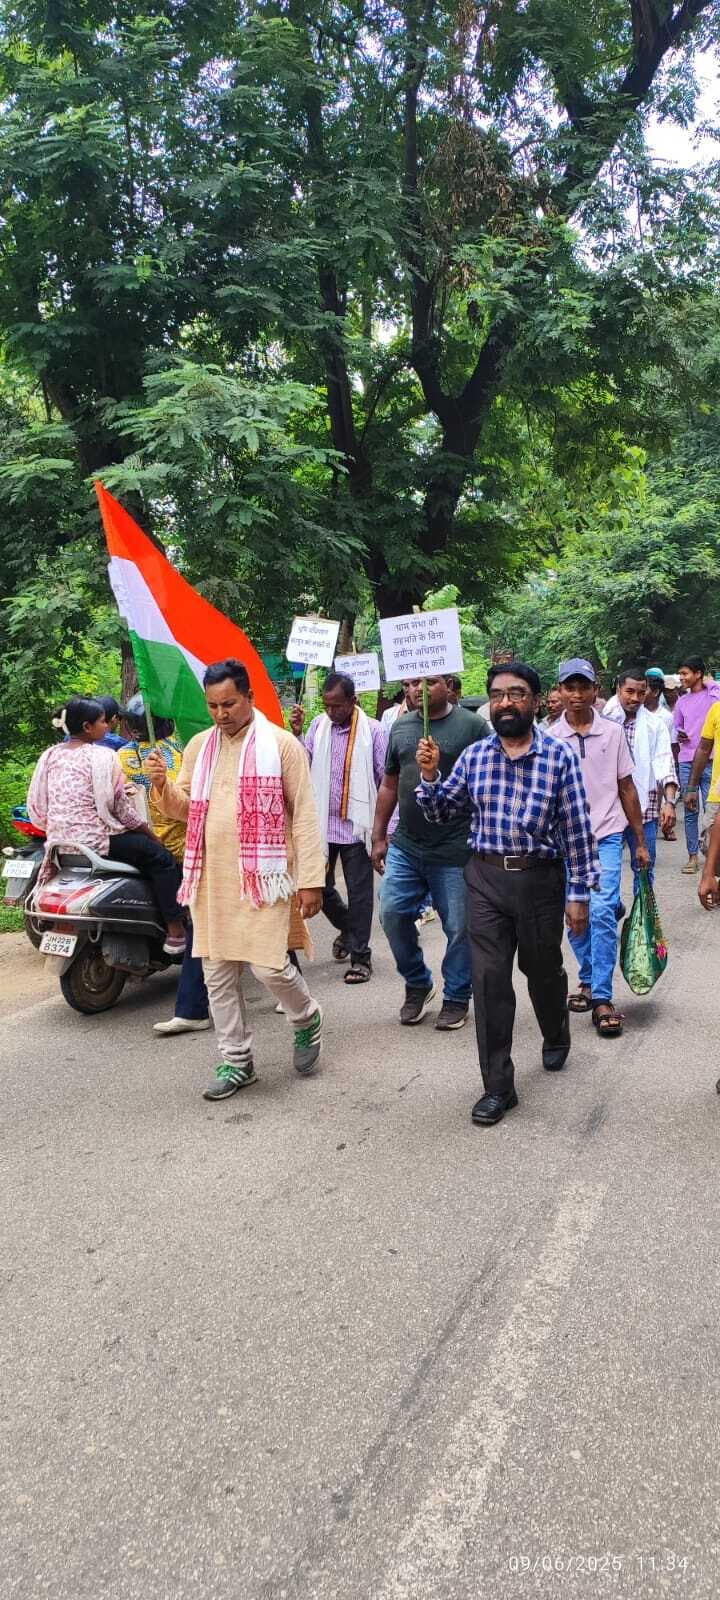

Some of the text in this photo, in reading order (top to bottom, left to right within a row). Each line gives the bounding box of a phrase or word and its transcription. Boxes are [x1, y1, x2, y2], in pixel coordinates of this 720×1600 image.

[395, 617, 438, 631] ग्राम सभा की
[393, 630, 444, 645] सहमति के बिना
[393, 644, 447, 659] जमीन अधिग्रहण
[398, 661, 417, 671] करना
[432, 657, 445, 667] करो
[44, 942, 69, 953] 8374
